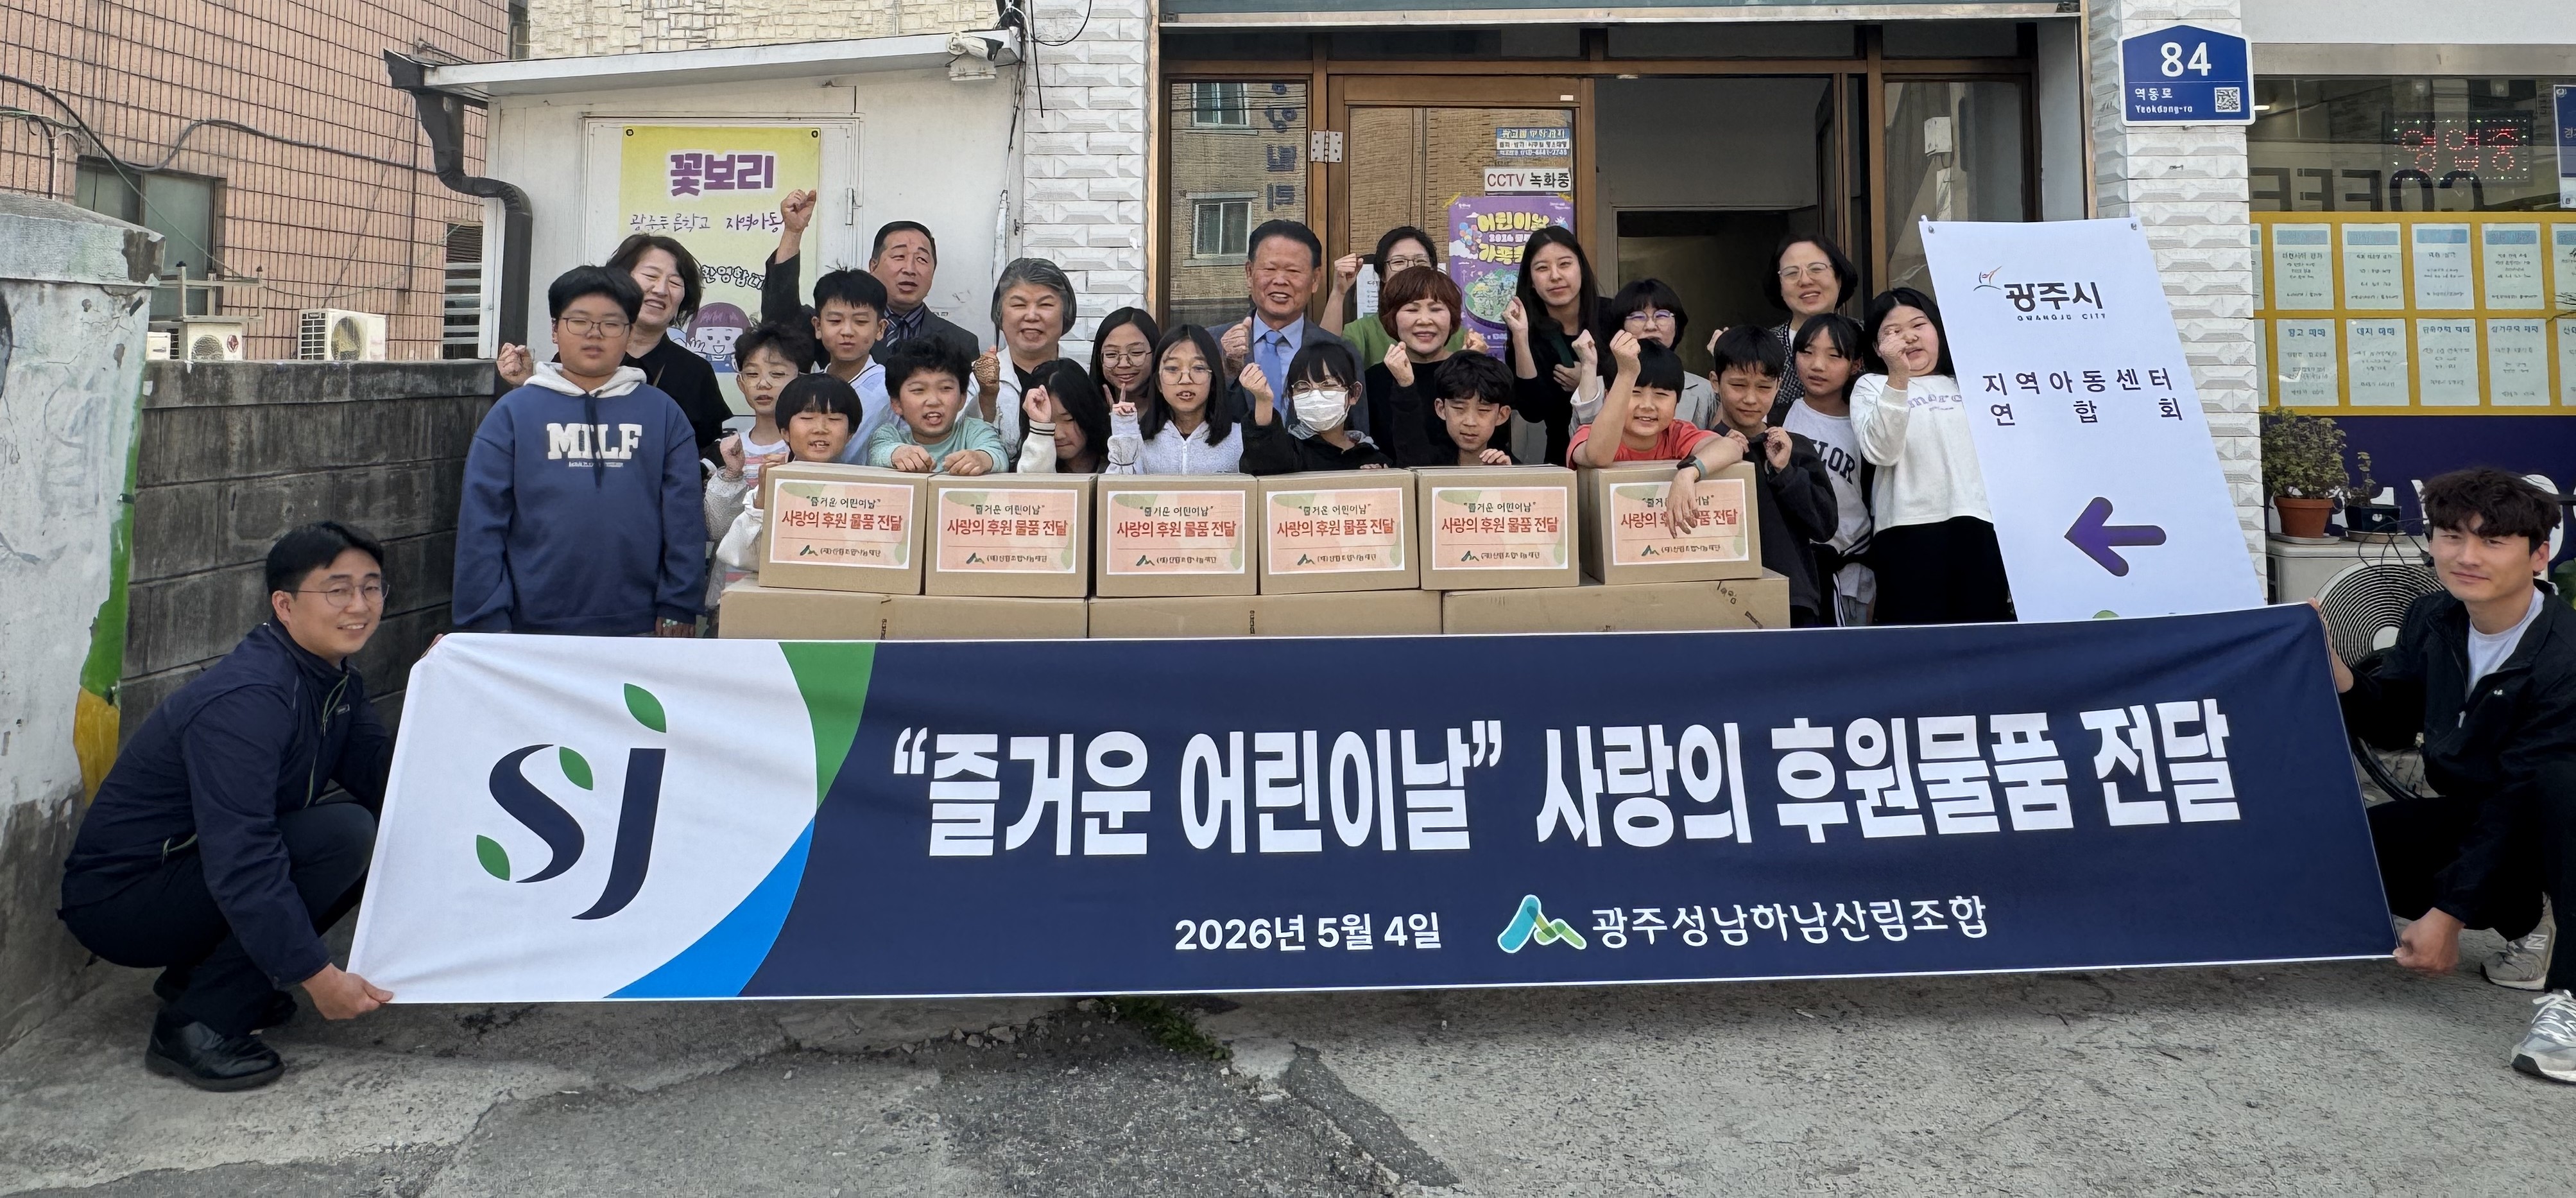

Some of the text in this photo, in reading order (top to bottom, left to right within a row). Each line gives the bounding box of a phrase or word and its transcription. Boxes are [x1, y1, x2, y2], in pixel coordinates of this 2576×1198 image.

[2161, 42, 2211, 77] 84
[2135, 88, 2173, 101] 역동로
[2401, 128, 2519, 172] 영업중
[670, 153, 774, 196] 꽃보리
[1487, 172, 1570, 188] CCTV 녹화중
[726, 212, 784, 233] 지역아동
[2004, 282, 2103, 312] 광주시
[547, 423, 642, 460] MILF
[1810, 439, 1853, 485] LOR
[1642, 497, 1669, 508] “즐거
[782, 510, 903, 532] 사랑의 후원 물품 전달
[947, 519, 1068, 536] 사랑의 후원 물품 전달
[1277, 517, 1395, 537] 사랑의 후원 물품 전달
[1442, 517, 1559, 534] 사랑의 후원 물품 전달
[1621, 513, 1657, 528] 사랑의
[1713, 508, 1738, 525] 전달
[1117, 521, 1237, 538] 사랑의 후원 물품 전달
[893, 699, 2240, 856] “즐거운 어린이날” 사랑의 후원물품 전달
[1175, 912, 1441, 951] 2026년 5월 4일
[1592, 895, 1988, 949] 광주성남하남산림조합
